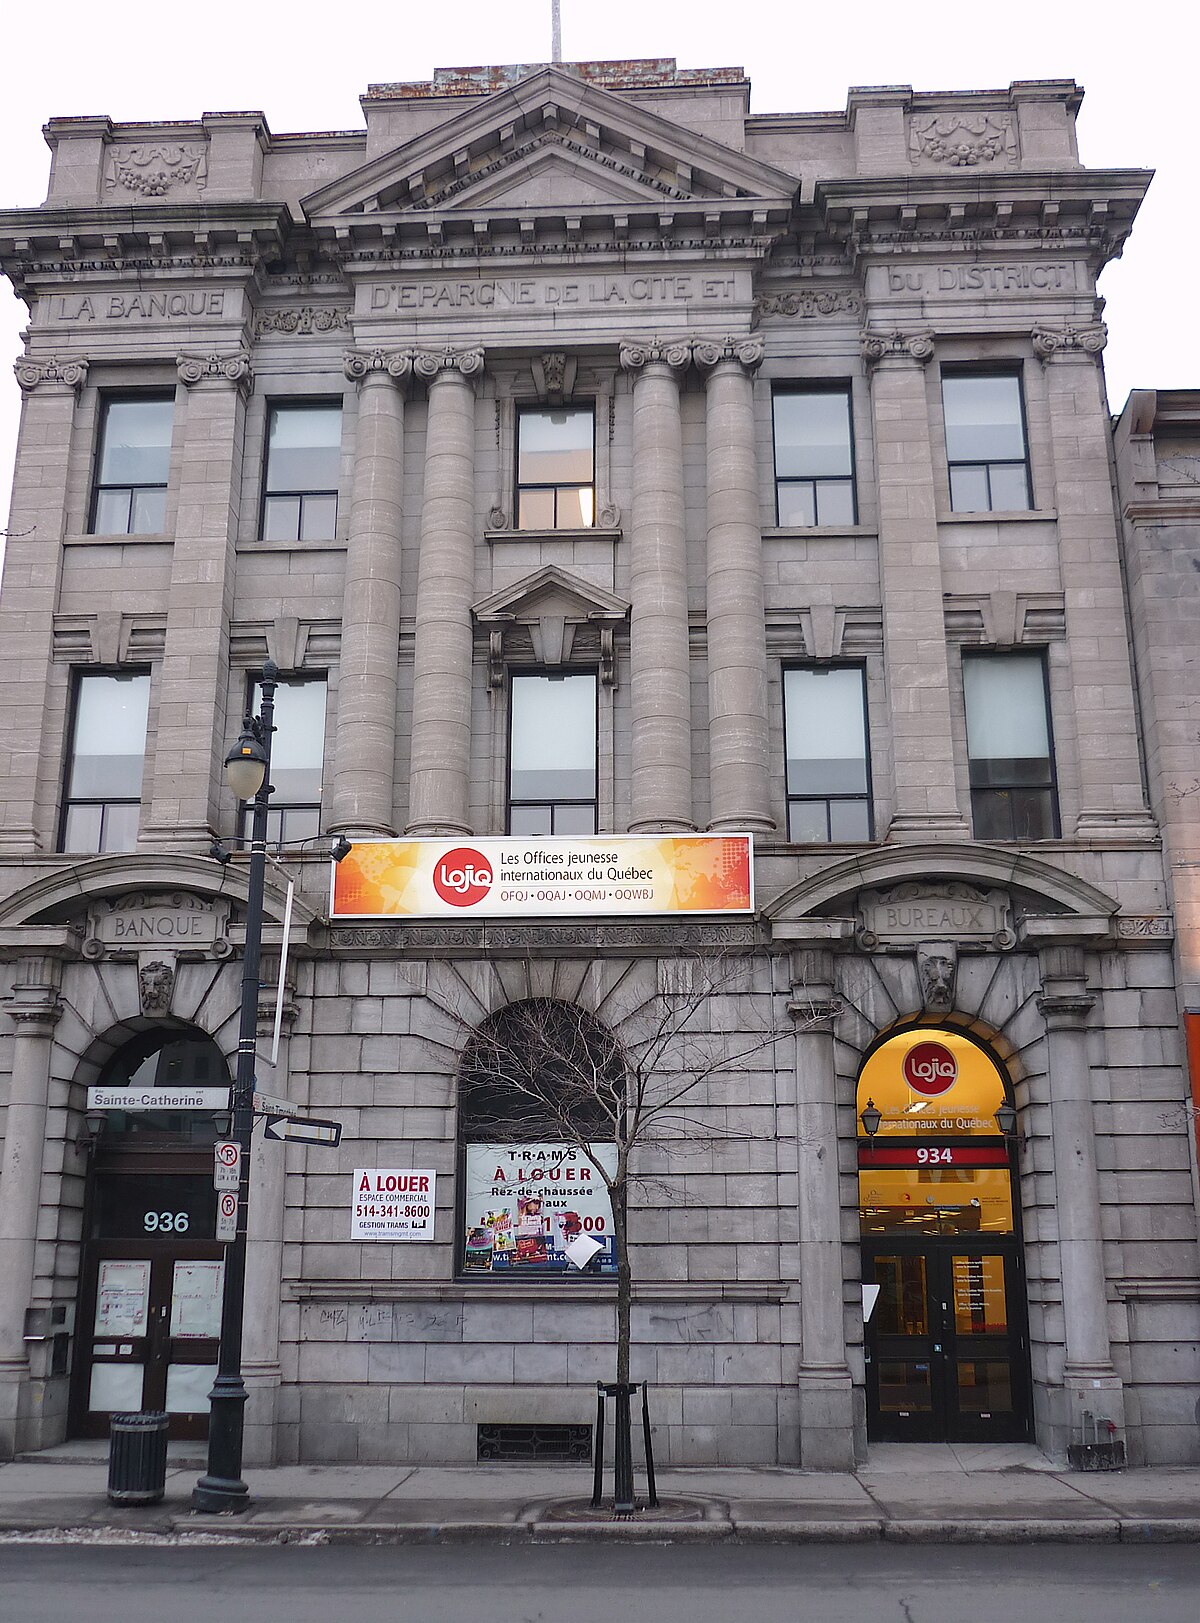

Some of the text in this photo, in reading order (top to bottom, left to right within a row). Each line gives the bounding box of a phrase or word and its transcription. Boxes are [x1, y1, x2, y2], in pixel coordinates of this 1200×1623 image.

[889, 266, 1066, 292] DU DISTRICT
[545, 285, 579, 303] DE
[588, 283, 625, 302] LA
[628, 277, 693, 300] CITE
[702, 280, 735, 298] ET
[58, 292, 224, 320] LA BANQUE
[500, 851, 618, 867] Les Offices jeunesse
[500, 866, 653, 882] internationaux du Québec
[500, 888, 654, 902] OFQJ OQAJ OQMJ OQWBJ
[886, 908, 984, 928] BUREAUX
[114, 916, 203, 937] BANQUE
[94, 1094, 203, 1106] Sainte-Catherine
[940, 1116, 953, 1130] du
[956, 1117, 993, 1131] Québec
[916, 1148, 953, 1164] 934
[493, 1164, 592, 1181] À LOUER
[359, 1171, 430, 1192] À LOUER
[359, 1193, 428, 1203] ESPACE COMMERCIAL
[491, 1186, 593, 1196] Rez-de-chaussée
[356, 1204, 430, 1218] 514-341-8600
[143, 1211, 190, 1233] 936
[359, 1221, 409, 1229] GESTION TRAMS
